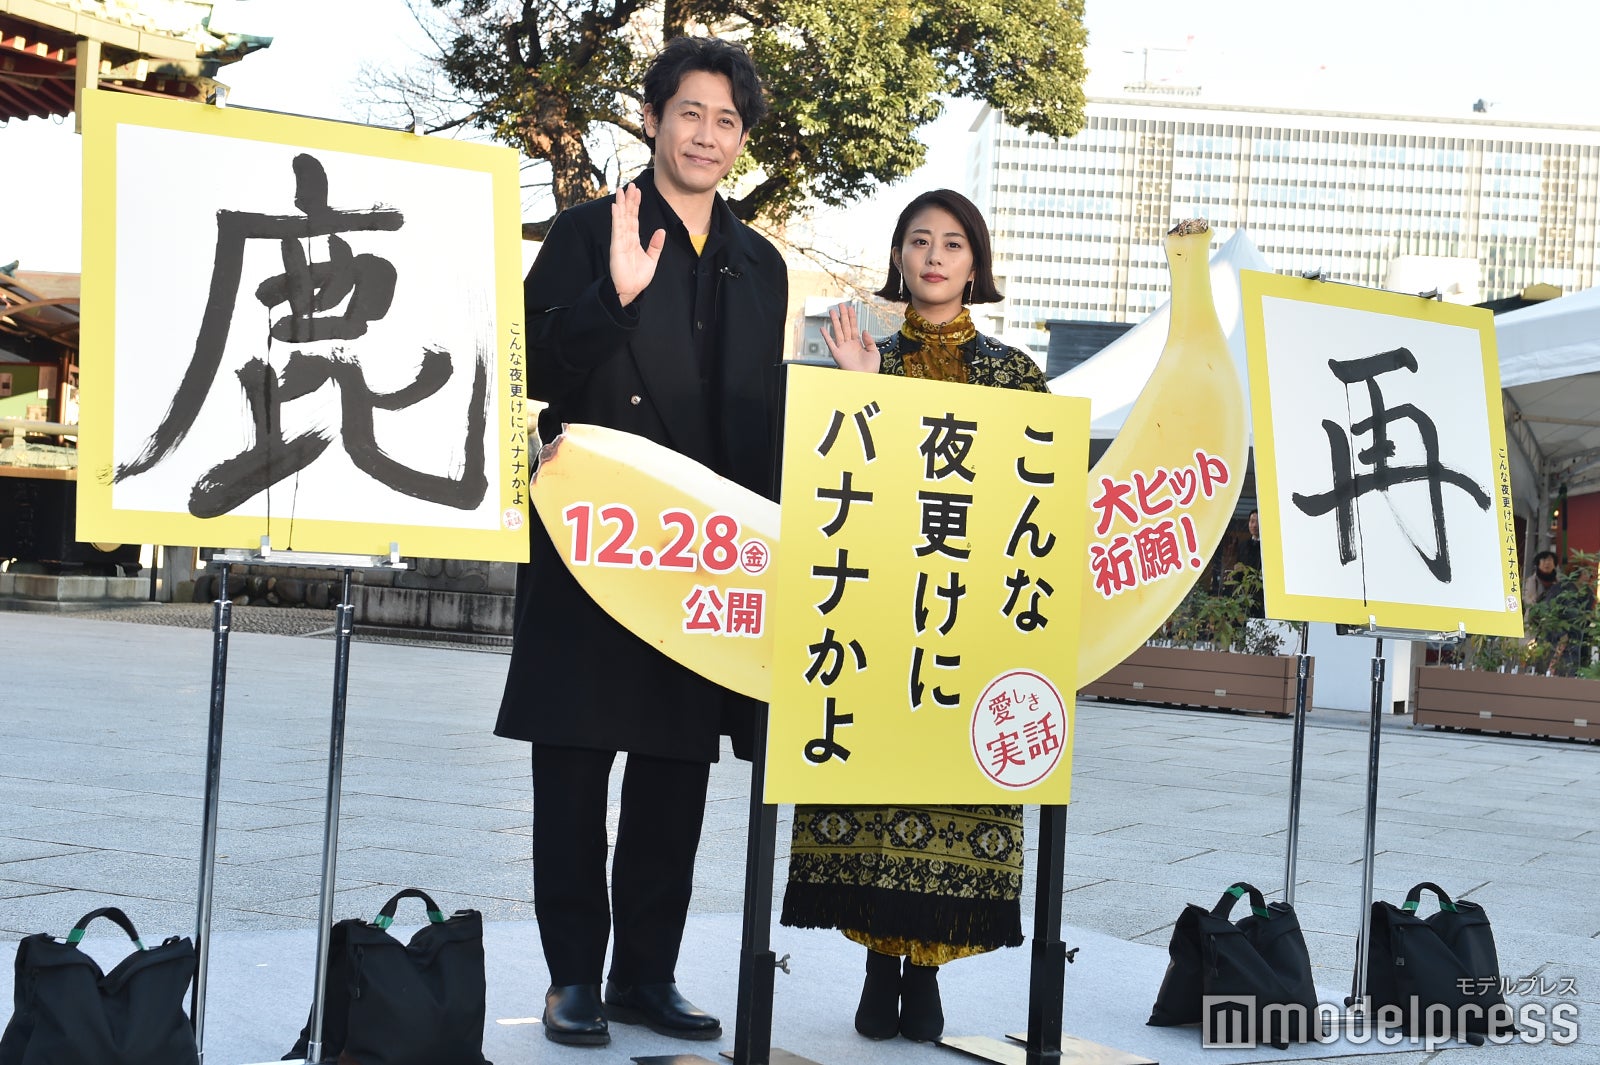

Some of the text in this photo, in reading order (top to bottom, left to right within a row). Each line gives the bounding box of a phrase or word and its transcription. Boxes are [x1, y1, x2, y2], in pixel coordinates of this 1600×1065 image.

[114, 153, 491, 518] 鹿
[509, 322, 526, 505] こんな夜更けにバナナかよ
[1002, 424, 1057, 632] こんな
[1092, 452, 1229, 535] 大ヒット
[1292, 347, 1492, 583] 再
[1498, 448, 1518, 593] こんな夜更けにバナナかよ
[686, 588, 763, 635] 公開
[803, 401, 880, 764] バナナかよ
[910, 412, 978, 711] 夜更けに
[986, 712, 1059, 777] 実話
[988, 689, 1039, 726] 愛しき
